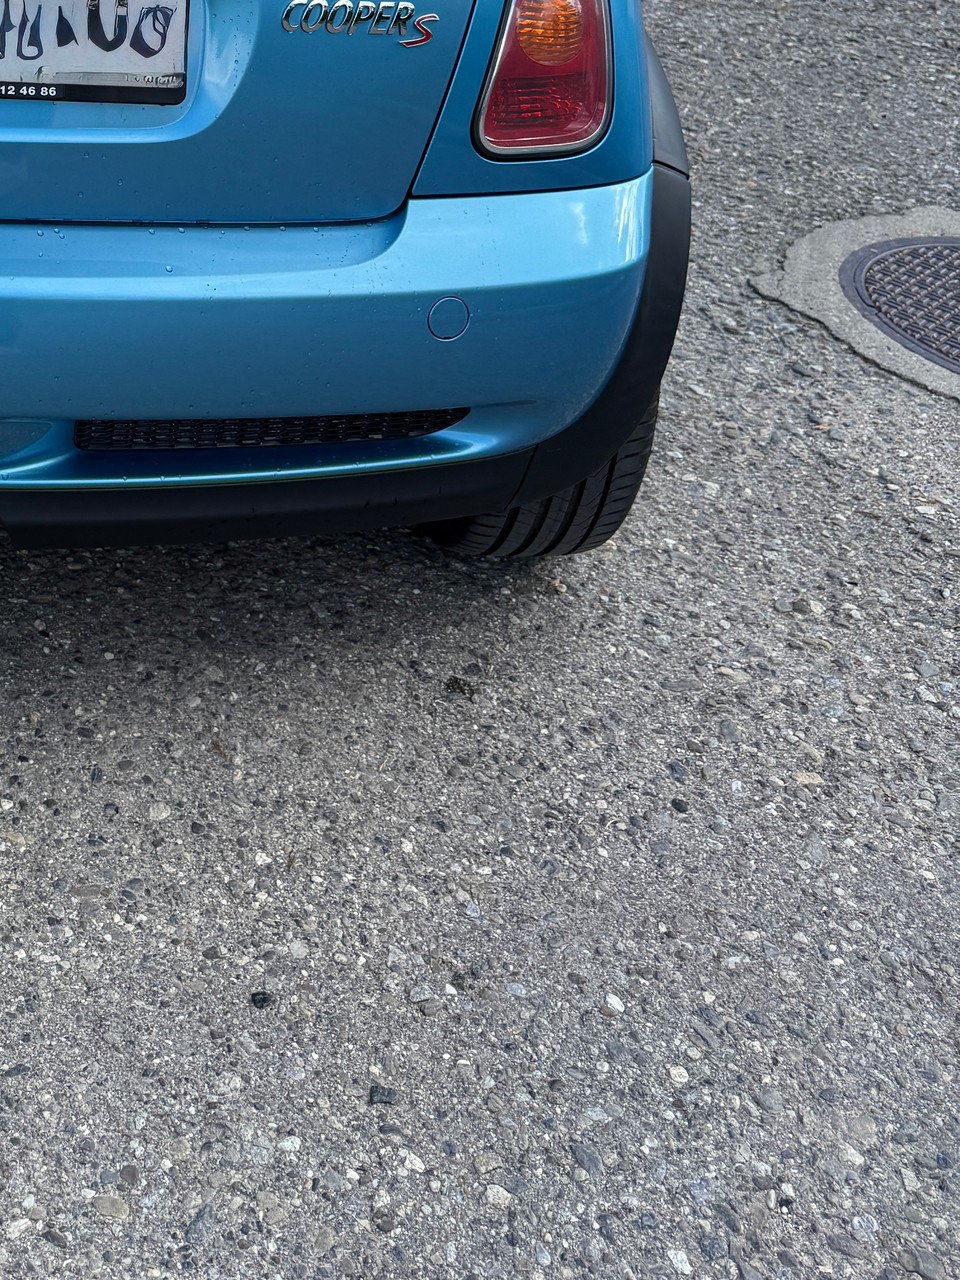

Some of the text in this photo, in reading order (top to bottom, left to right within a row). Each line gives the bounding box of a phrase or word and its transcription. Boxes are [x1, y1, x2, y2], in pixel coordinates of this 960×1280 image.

[398, 13, 440, 48] S
[19, 85, 36, 96] 46
[40, 86, 57, 96] 86
